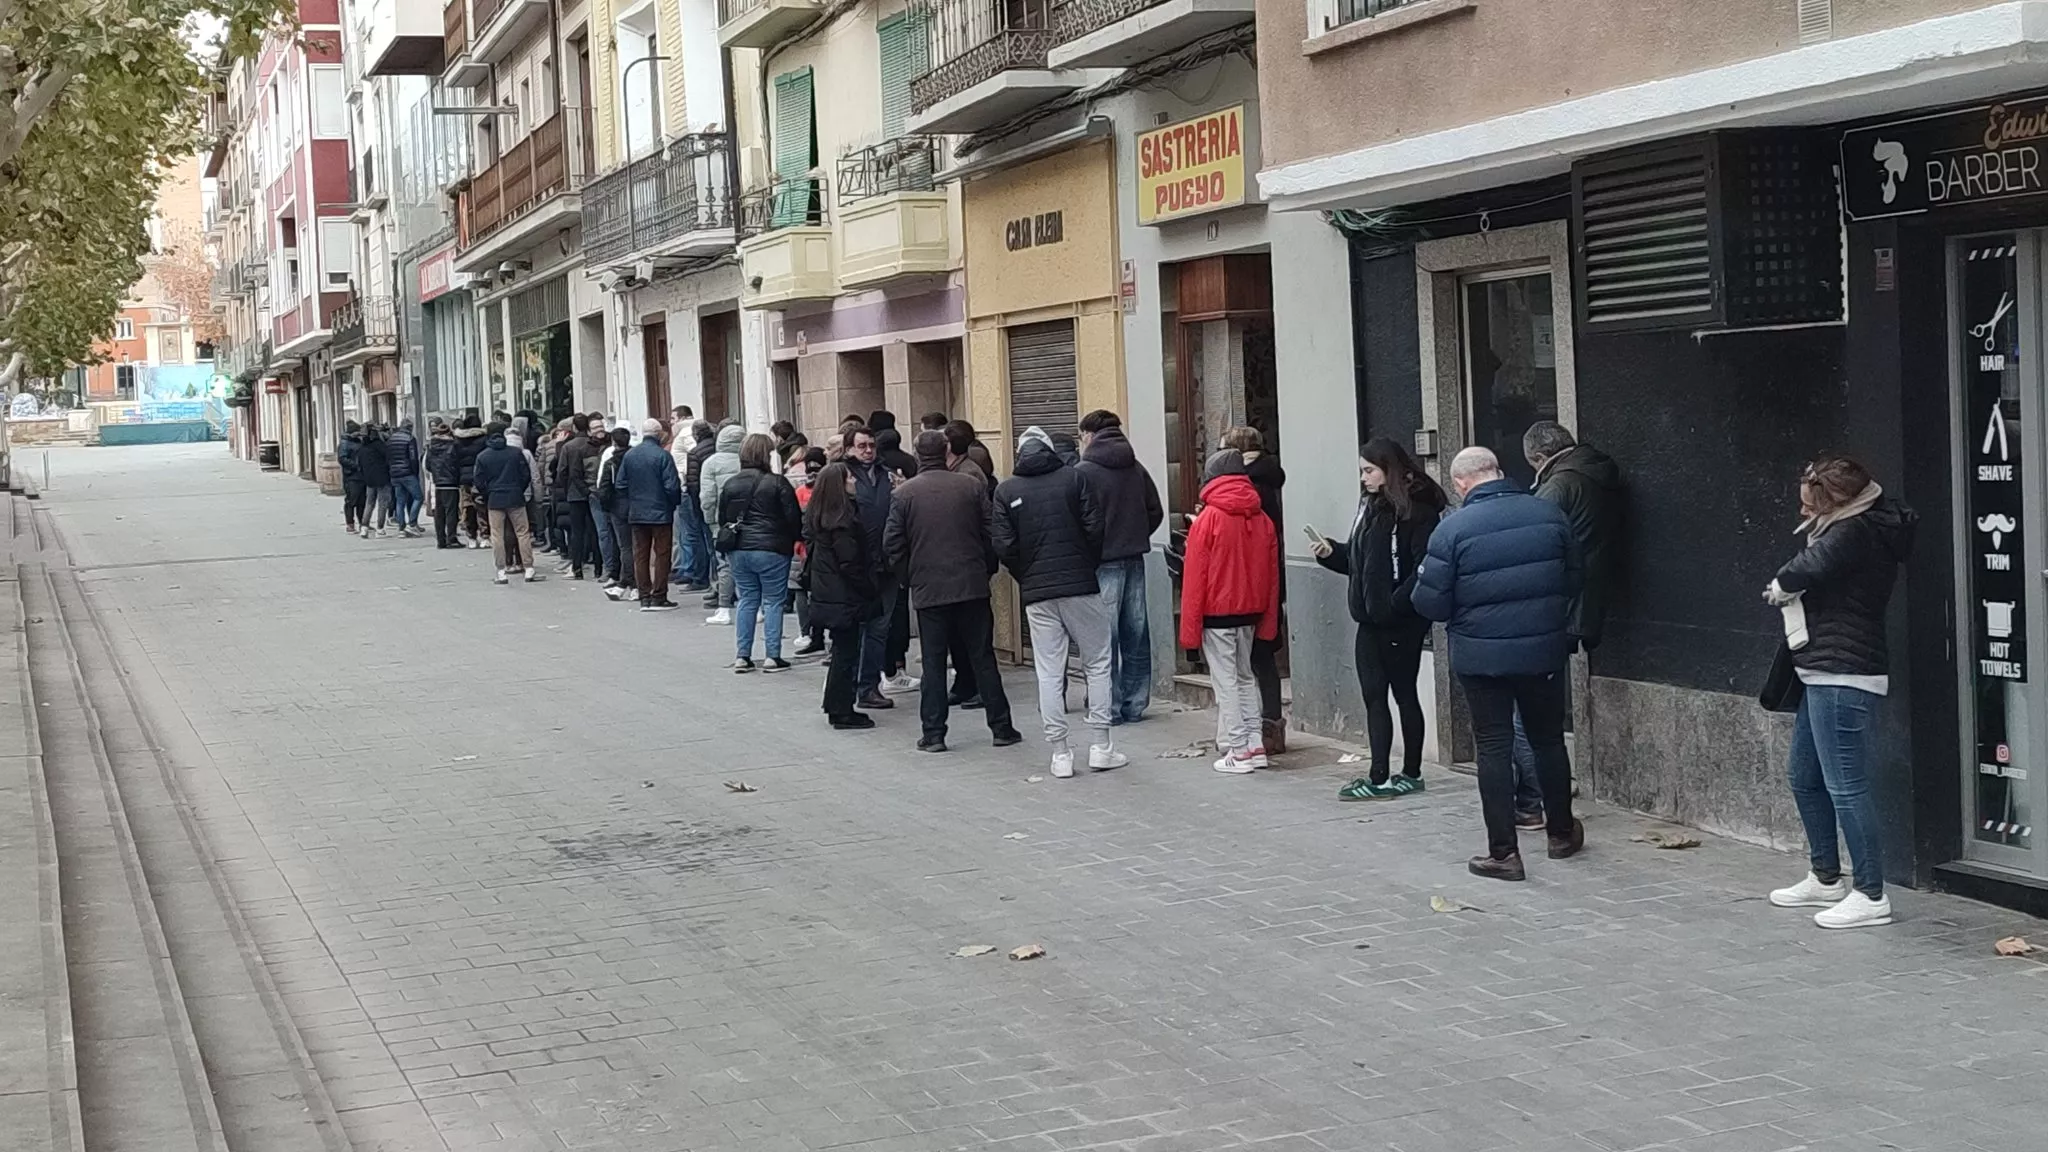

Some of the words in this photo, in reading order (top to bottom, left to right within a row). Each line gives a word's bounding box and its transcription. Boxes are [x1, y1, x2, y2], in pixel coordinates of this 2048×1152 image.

[1141, 112, 1239, 179] SASTRERIA
[1927, 146, 2041, 202] BARBER
[1156, 171, 1224, 214] PUEYO
[1006, 217, 1032, 252] CASA
[1980, 355, 2004, 371] HAIR
[1978, 465, 2013, 481] SHAVE
[1985, 554, 2010, 570] TRIM
[1990, 643, 2010, 658] HOT
[1981, 660, 2021, 679] TOWELS
